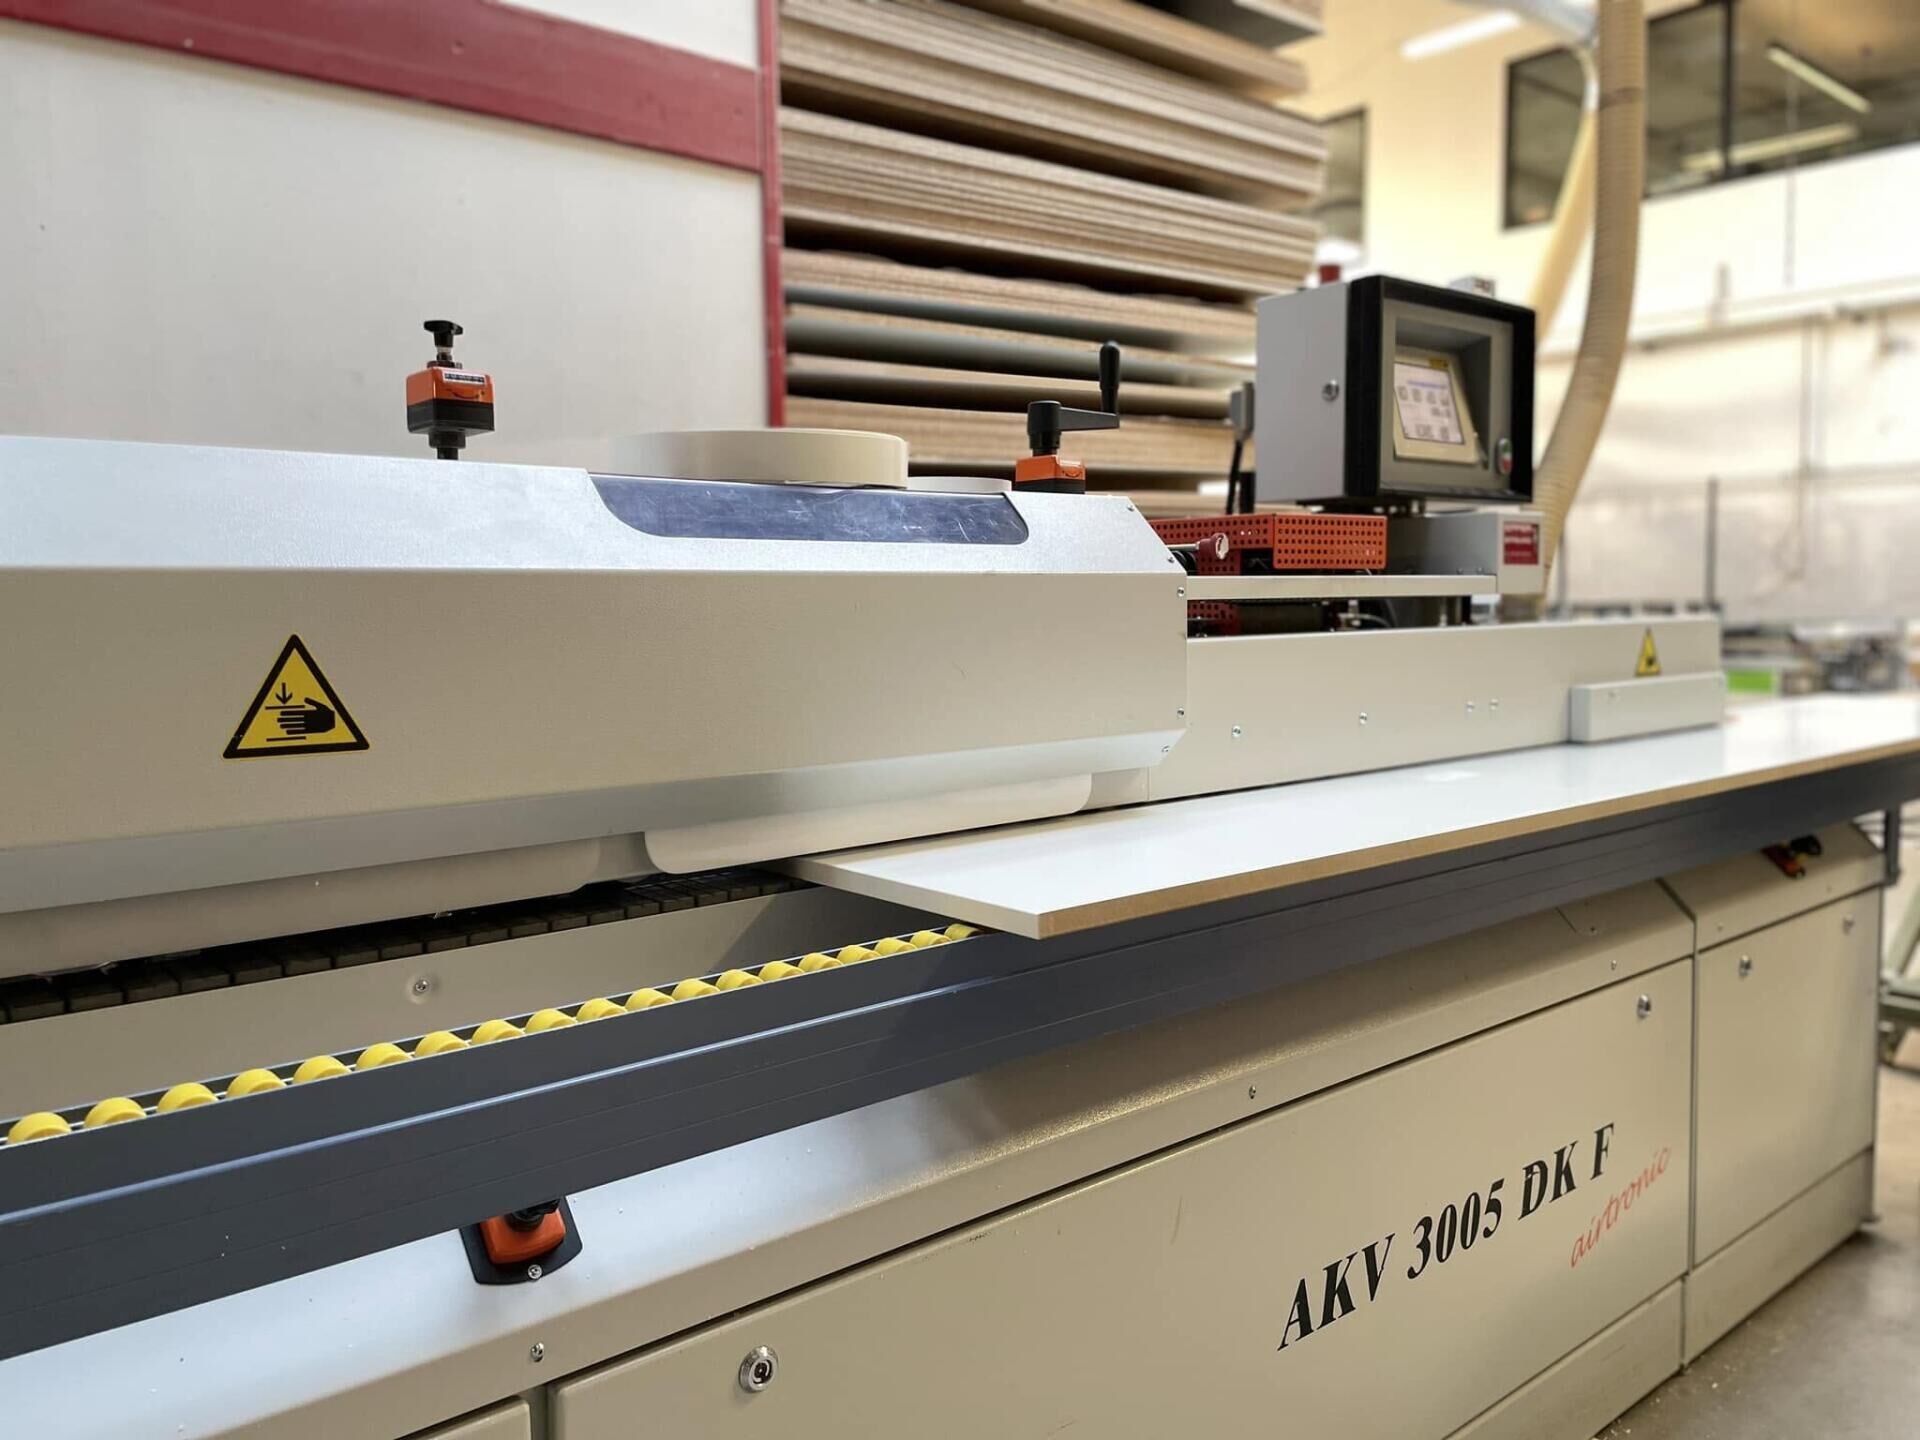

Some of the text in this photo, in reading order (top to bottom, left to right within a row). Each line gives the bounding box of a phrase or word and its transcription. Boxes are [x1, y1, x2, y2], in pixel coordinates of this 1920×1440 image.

[1277, 1122, 1615, 1351] AKV 3005 DK F
[1570, 1146, 1671, 1268] airtronic
